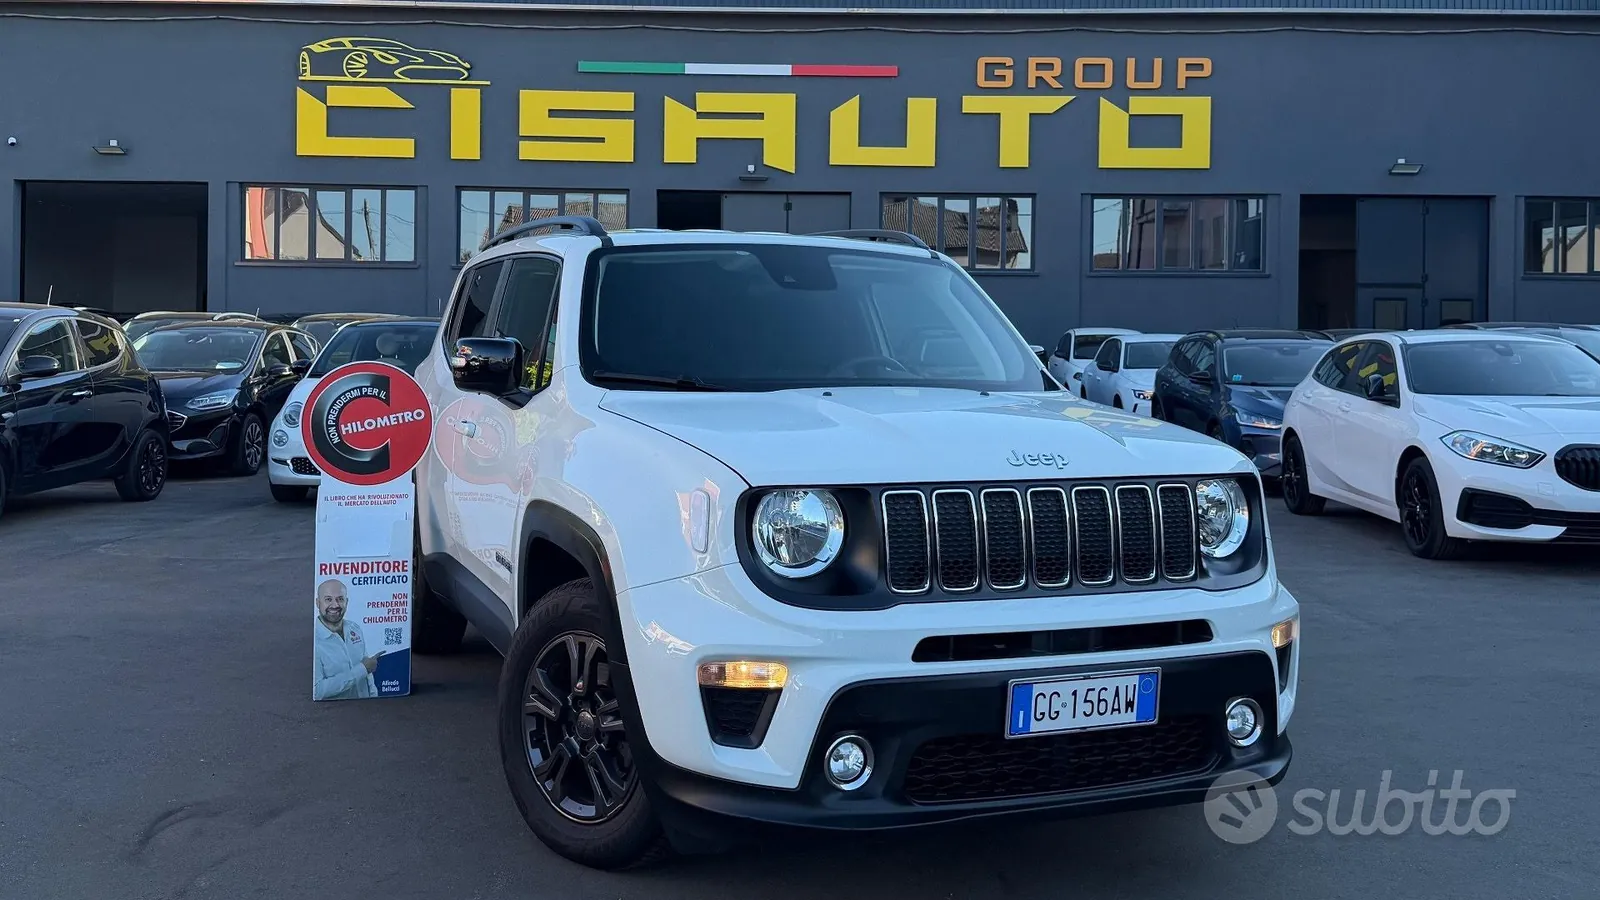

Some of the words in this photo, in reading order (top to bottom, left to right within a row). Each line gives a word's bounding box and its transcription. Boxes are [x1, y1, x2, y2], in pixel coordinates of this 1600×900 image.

[977, 56, 1213, 90] GROUP
[296, 86, 1212, 173] CISAUTO
[362, 387, 379, 396] PER
[380, 390, 387, 399] IL
[327, 388, 361, 425] PRENDERMI
[327, 426, 341, 444] NON
[1006, 448, 1070, 470] Jeep
[319, 560, 408, 576] RIVENDITORE
[351, 574, 408, 586] CERTIFICATO
[367, 600, 408, 608] PRENDERMI
[363, 615, 408, 624] CHILOMETRO
[381, 685, 400, 693] Bellucci
